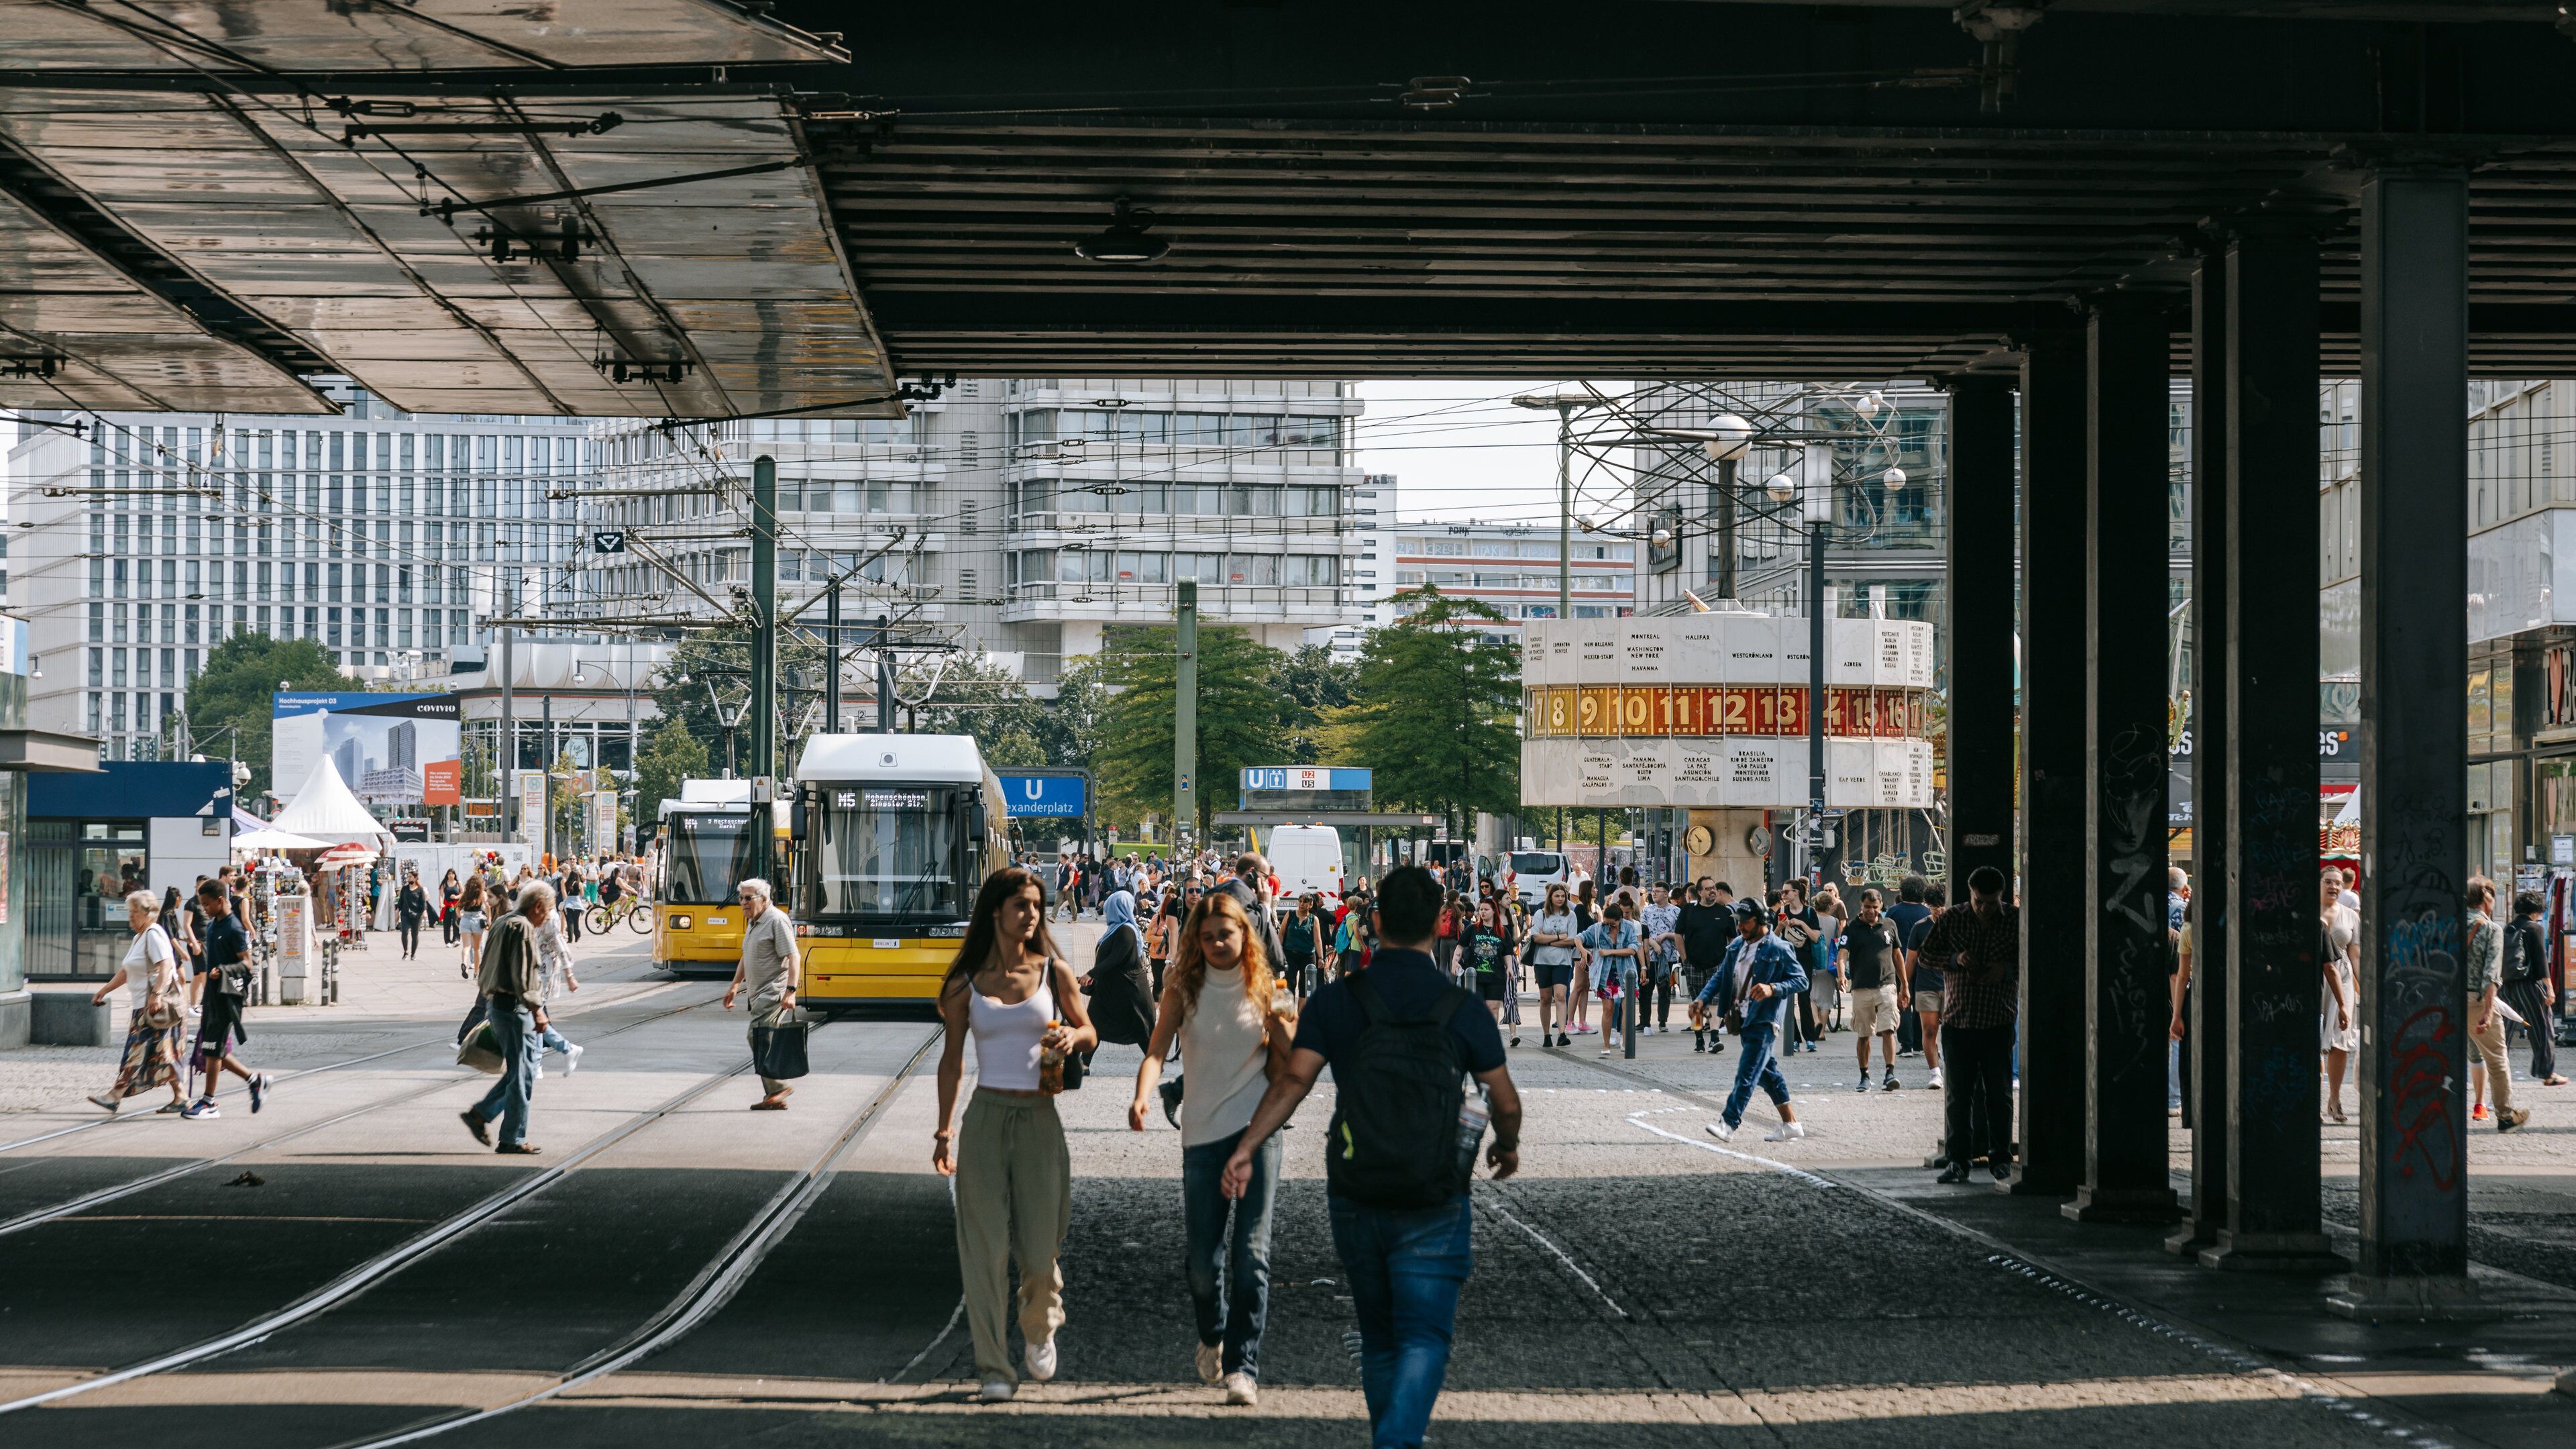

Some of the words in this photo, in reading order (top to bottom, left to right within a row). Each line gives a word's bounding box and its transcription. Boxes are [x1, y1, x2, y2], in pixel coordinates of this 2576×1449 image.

[1537, 697, 1544, 726] 7
[1553, 697, 1564, 726] 8
[1580, 696, 1598, 726] 9
[1612, 696, 1647, 725] 10
[1660, 696, 1689, 725] 11
[1708, 695, 1746, 724] 12
[1760, 695, 1796, 725] 13
[1823, 696, 1840, 725] 4
[1854, 697, 1878, 726] 15
[1887, 697, 1904, 727] 16
[1909, 698, 1919, 728] 17
[1026, 780, 1042, 800] U
[1248, 770, 1264, 788] U
[838, 792, 855, 808] M5
